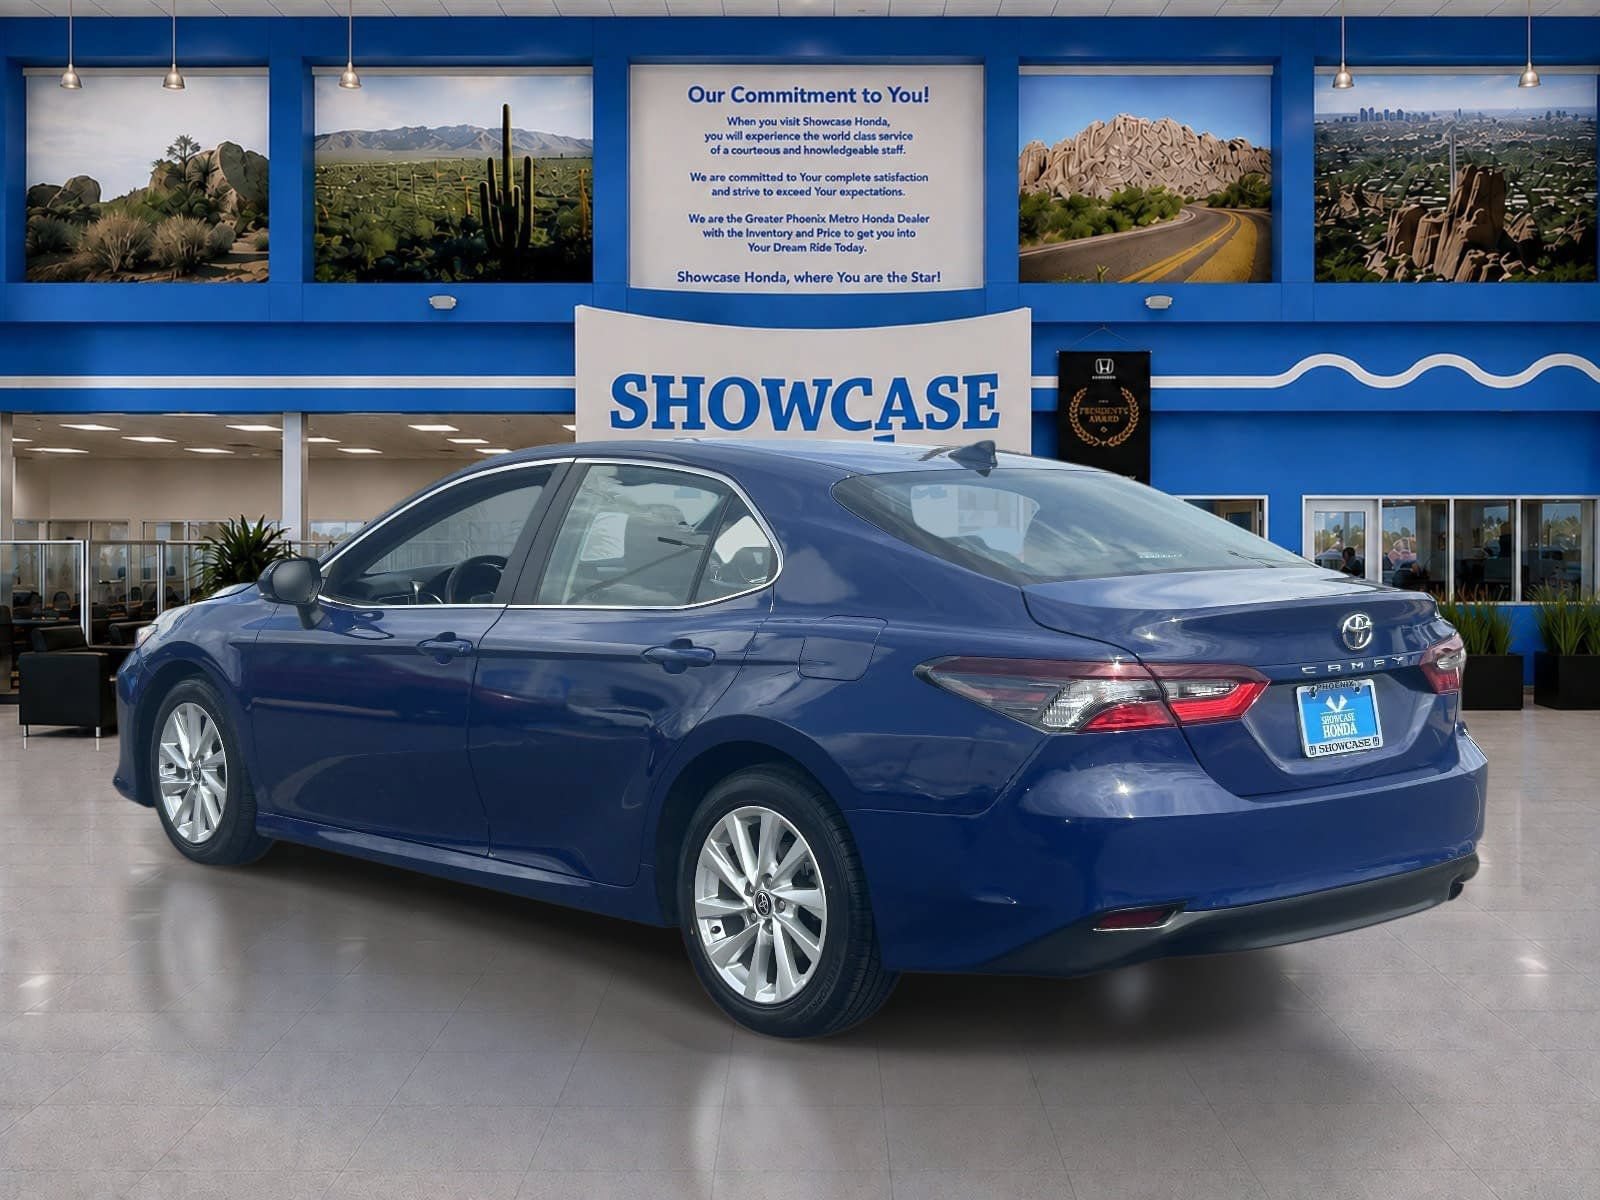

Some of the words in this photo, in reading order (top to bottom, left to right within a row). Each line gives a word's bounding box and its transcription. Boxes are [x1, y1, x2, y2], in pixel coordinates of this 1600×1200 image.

[688, 86, 726, 103] Our
[731, 86, 857, 103] Commitment
[861, 88, 883, 103] to
[887, 86, 930, 103] You!
[727, 117, 756, 127] When
[758, 119, 776, 129] you
[780, 117, 801, 127] visit
[803, 117, 852, 127] Showcase
[854, 117, 891, 128] Honda,
[704, 134, 723, 143] you
[726, 131, 743, 141] will
[746, 131, 800, 143] experience
[803, 131, 820, 141] the
[822, 131, 851, 141] world
[853, 131, 877, 141] class
[878, 131, 913, 141] service
[710, 145, 721, 155] of
[731, 147, 781, 155] courteous
[782, 145, 802, 155] and
[881, 145, 906, 155] staff.
[690, 172, 706, 182] We
[728, 172, 784, 182] committed
[786, 173, 798, 182] to
[799, 172, 822, 182] Your
[824, 172, 871, 184] complete
[873, 172, 929, 182] satisfaction
[711, 187, 731, 197] and
[732, 187, 760, 197] strive
[763, 188, 774, 197] to
[776, 187, 812, 197] exceed
[815, 187, 837, 197] Your
[839, 187, 905, 199] expectations.
[688, 214, 706, 224] We
[726, 214, 742, 224] the
[745, 214, 784, 224] Greater
[786, 214, 826, 224] Phoenix
[829, 214, 860, 224] Metro
[862, 214, 894, 224] Honda
[897, 214, 930, 224] Dealer
[702, 228, 724, 238] with
[727, 228, 743, 238] the
[745, 228, 793, 240] Inventory
[795, 228, 813, 238] and
[817, 228, 841, 238] Price
[843, 230, 855, 238] to
[856, 230, 874, 241] get
[876, 231, 895, 241] you
[896, 228, 916, 238] into
[748, 243, 771, 253] Your
[773, 243, 807, 253] Dream
[809, 243, 832, 253] Ride
[834, 243, 867, 255] Today.
[677, 271, 740, 283] Showcase
[744, 271, 790, 285] Honda,
[793, 271, 834, 283] where
[837, 271, 860, 283] You
[863, 274, 884, 283] are
[886, 271, 908, 283] the
[911, 271, 941, 283] Star!
[610, 372, 1000, 431] SHOWCASE
[1321, 712, 1356, 725] SHOWCASE
[1323, 723, 1358, 738] HONDA
[1318, 738, 1372, 754] SHOWCASE
